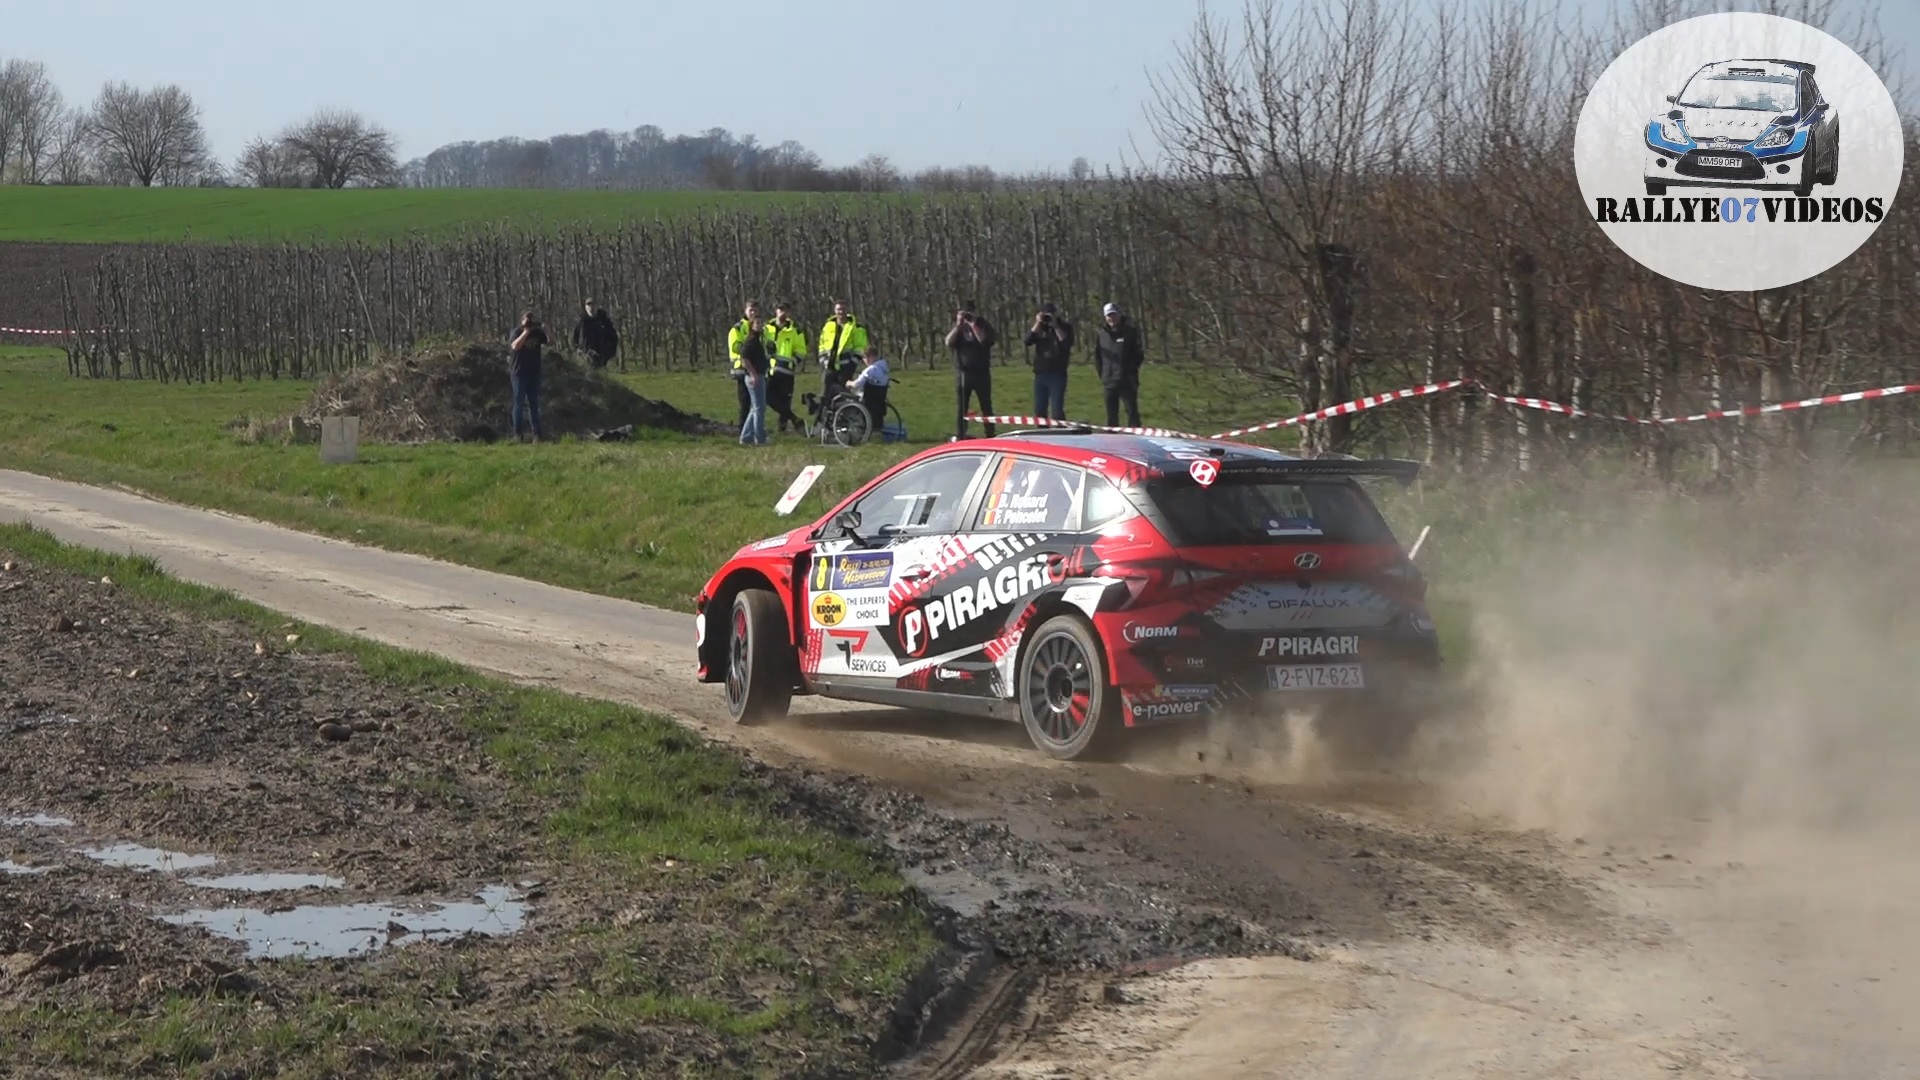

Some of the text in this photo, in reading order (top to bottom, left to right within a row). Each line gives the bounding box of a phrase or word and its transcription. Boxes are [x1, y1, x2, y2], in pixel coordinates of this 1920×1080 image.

[816, 557, 828, 590] 8
[847, 596, 886, 605] THE EXPERTS
[924, 553, 1052, 640] PIRAGRI
[816, 604, 842, 615] KROON
[1267, 599, 1350, 610] DIFALUX
[823, 614, 835, 623] OIL
[856, 610, 879, 619] CHOICE
[1278, 635, 1359, 656] PIRAGRI
[1133, 700, 1203, 720] e-power
